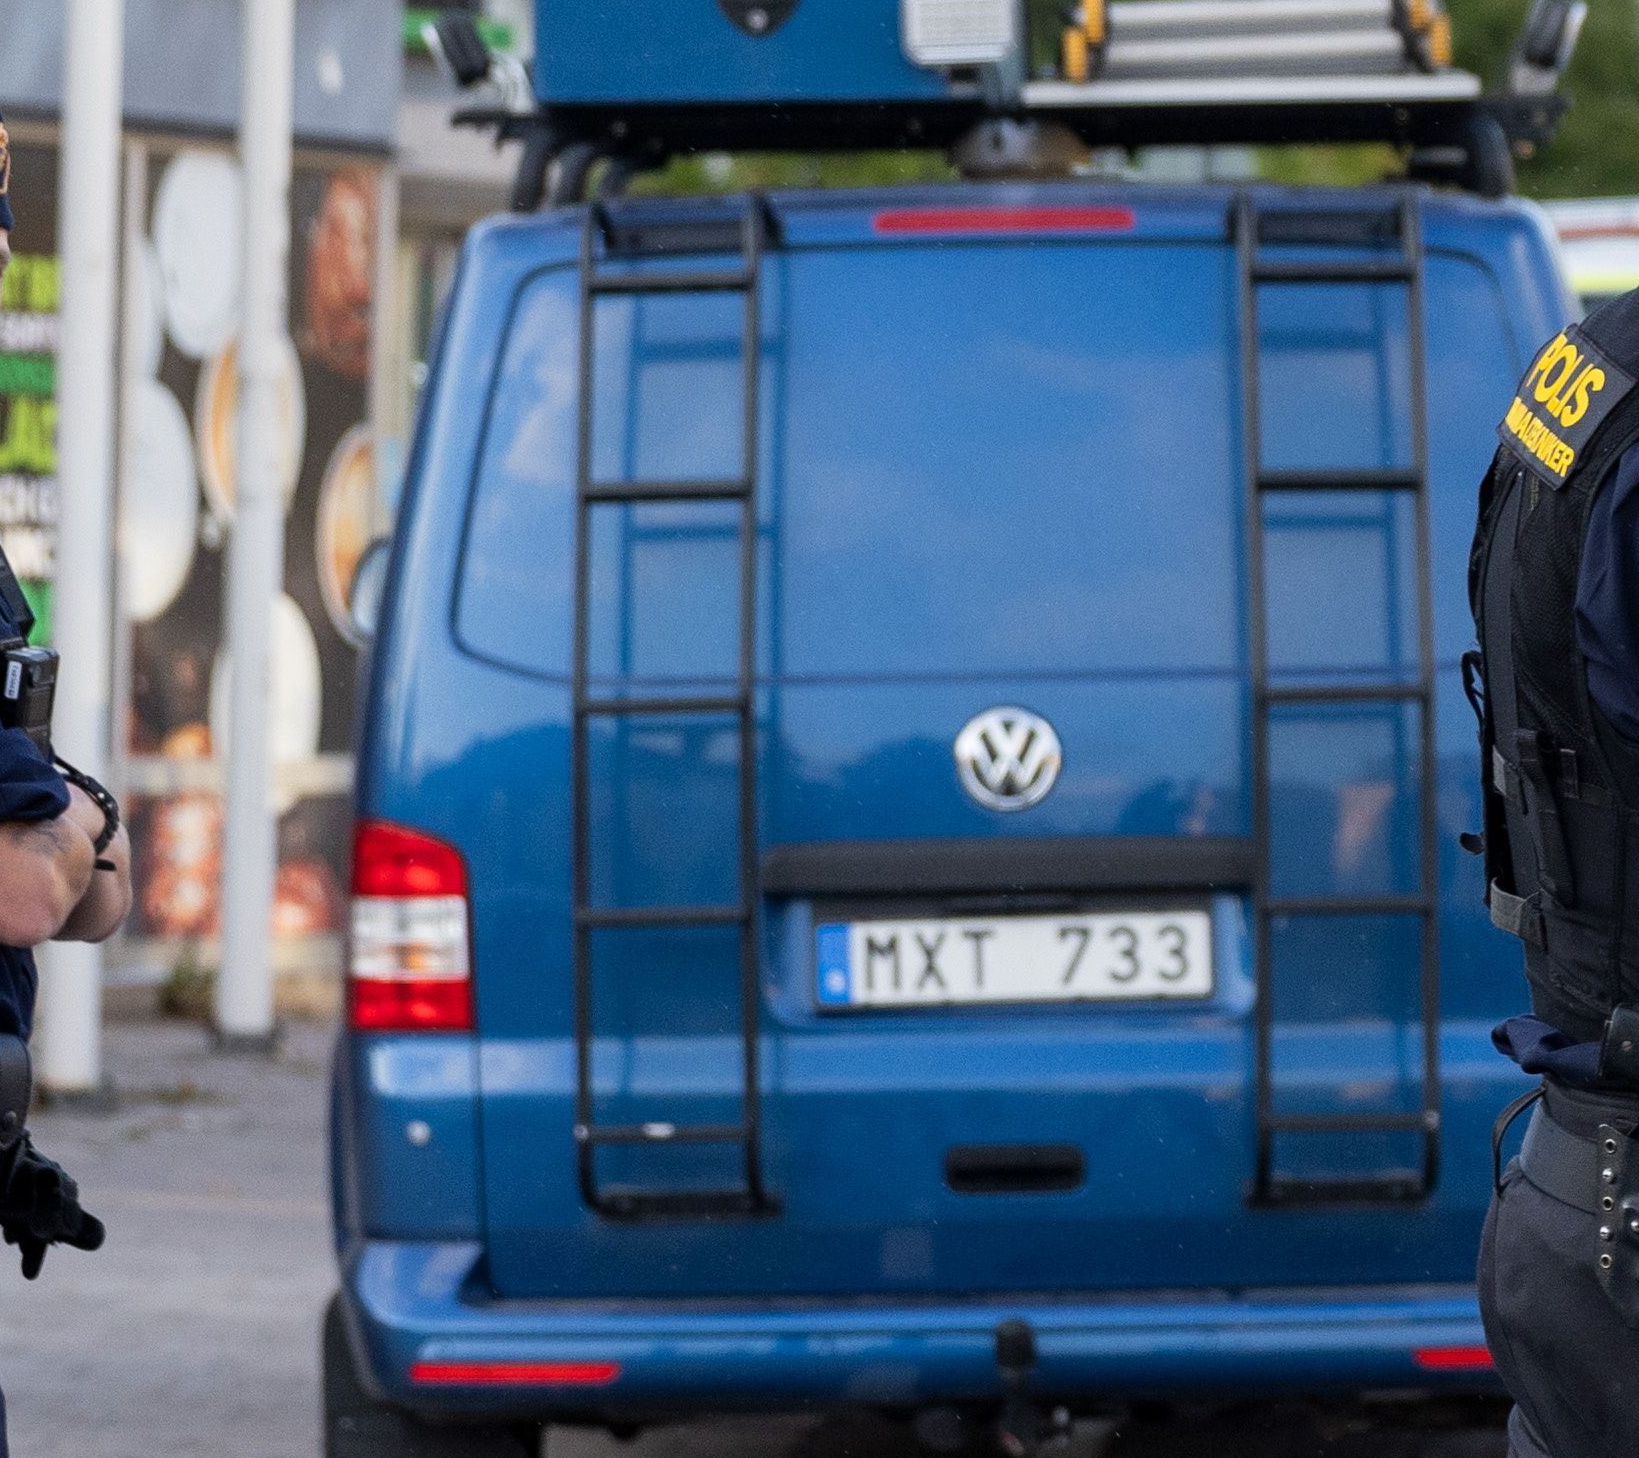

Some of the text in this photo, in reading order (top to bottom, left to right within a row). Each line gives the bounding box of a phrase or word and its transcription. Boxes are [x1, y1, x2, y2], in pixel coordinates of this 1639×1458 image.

[1526, 334, 1606, 428] POLIS
[864, 925, 1191, 991] MXT 733
